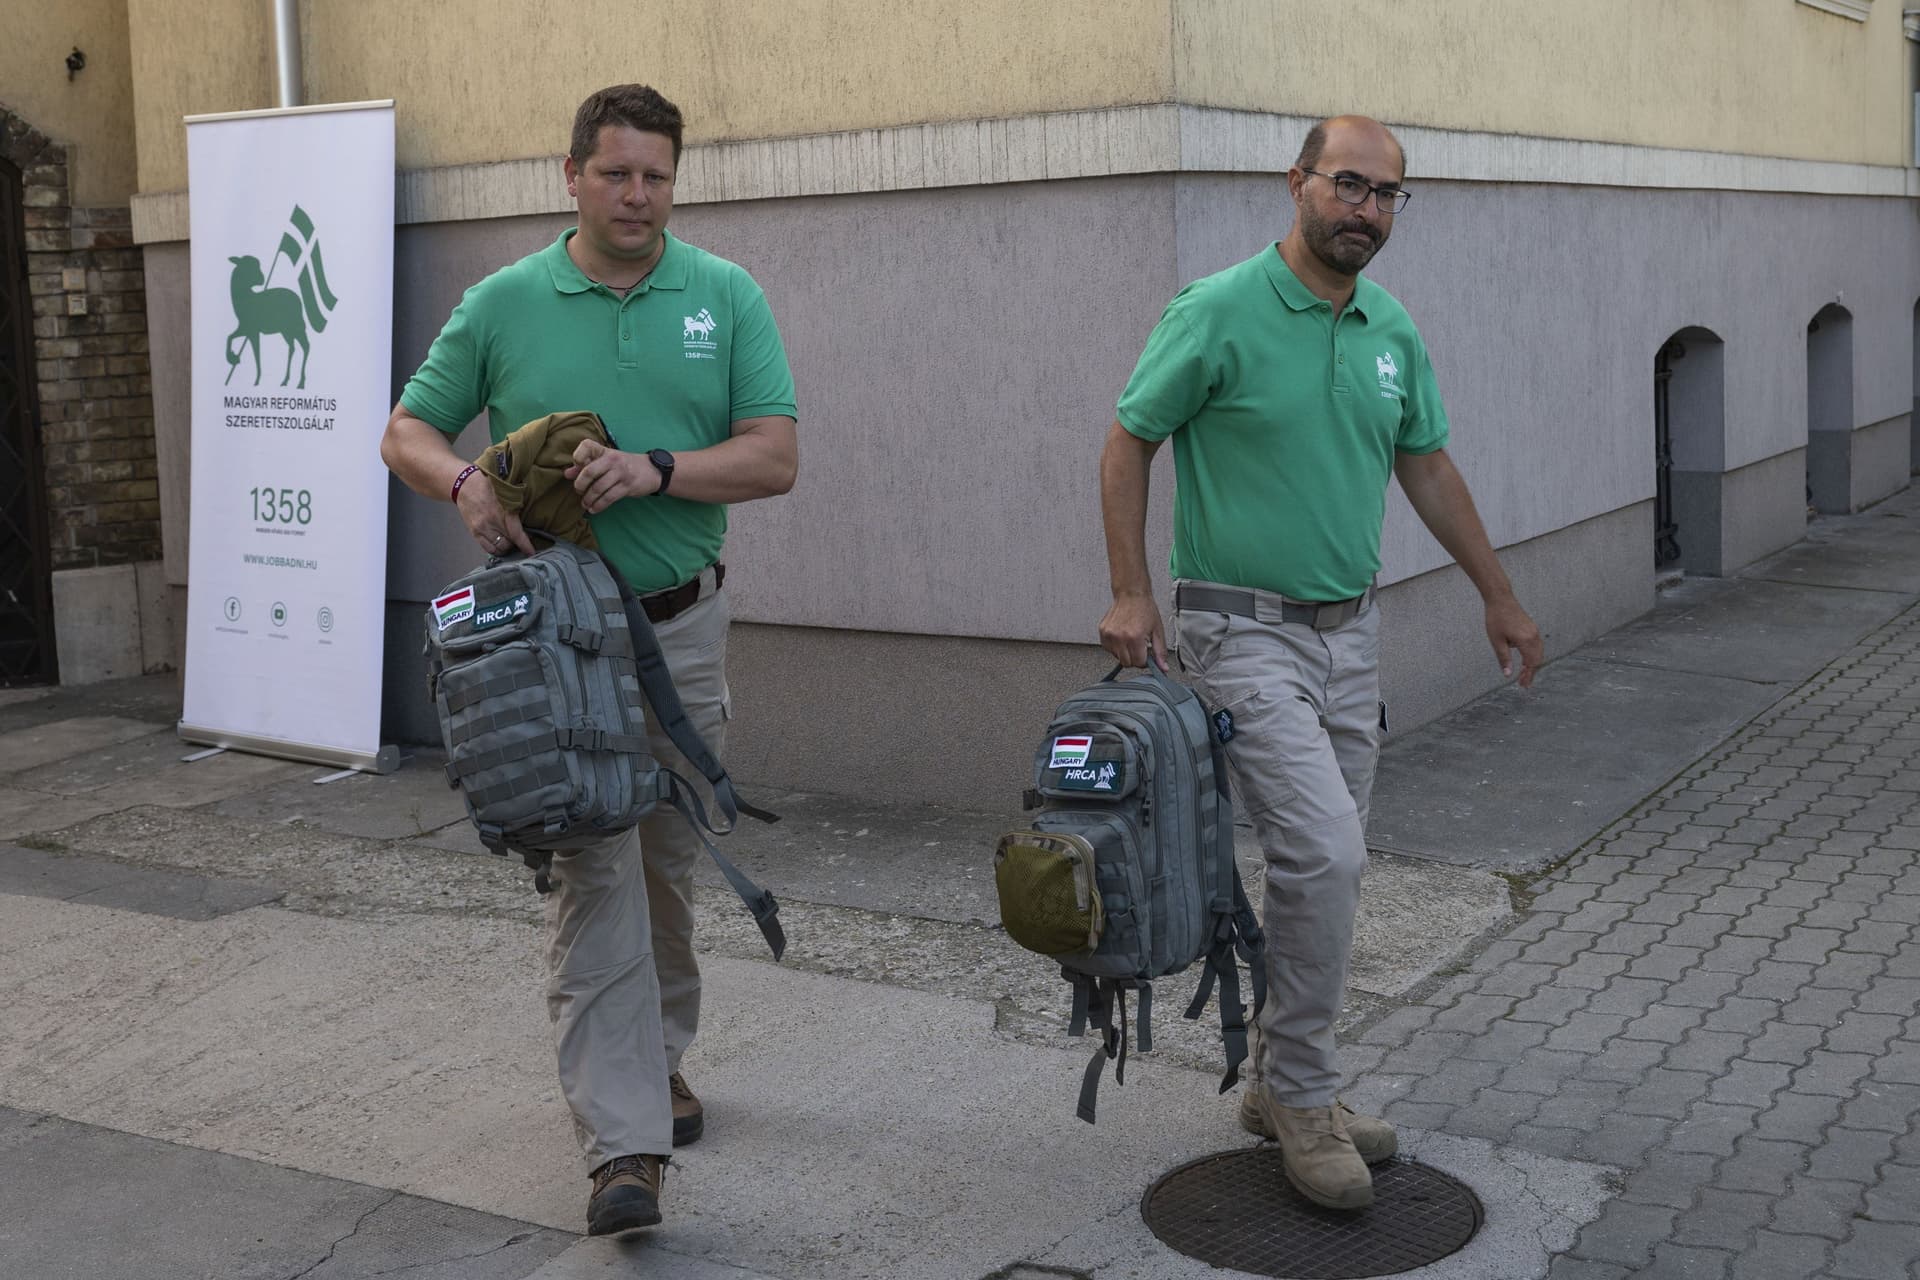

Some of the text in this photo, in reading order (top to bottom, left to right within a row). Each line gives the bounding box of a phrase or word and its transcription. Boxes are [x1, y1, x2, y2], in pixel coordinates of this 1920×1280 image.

[224, 396, 337, 412] MAGYAR REFORMÁTUS
[225, 414, 335, 431] SZERETETSZOLGÁLAT
[250, 486, 312, 525] 1358
[243, 553, 318, 570] WWW.JOBBADNI.HU
[440, 608, 472, 628] HUNGARY
[477, 606, 512, 625] HRCA
[1053, 758, 1083, 766] HUNGARY
[1065, 769, 1096, 781] HRCA
